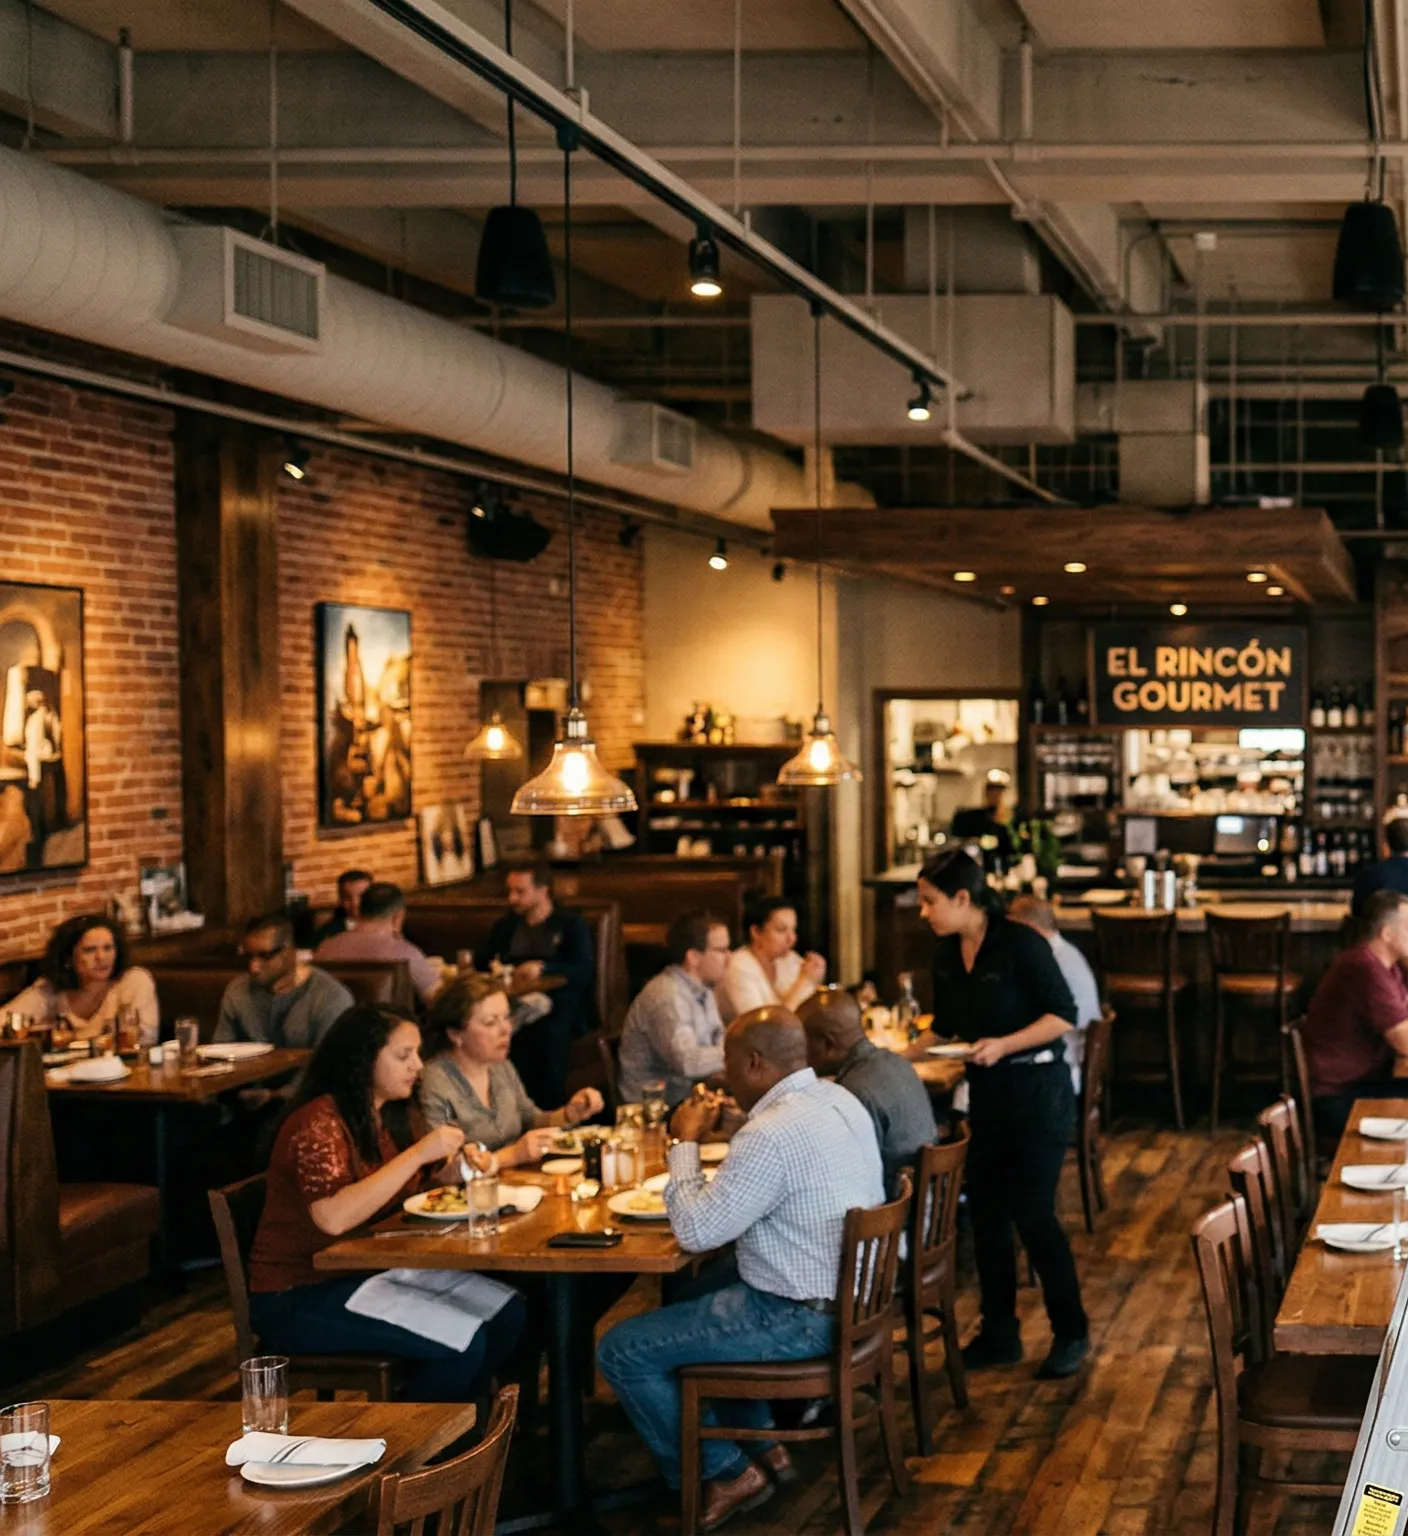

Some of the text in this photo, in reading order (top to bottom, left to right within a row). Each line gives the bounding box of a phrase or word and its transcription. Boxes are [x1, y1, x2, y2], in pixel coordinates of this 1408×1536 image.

[1106, 637, 1292, 678] EL RINCÓN
[1112, 679, 1286, 712] GOURMET
